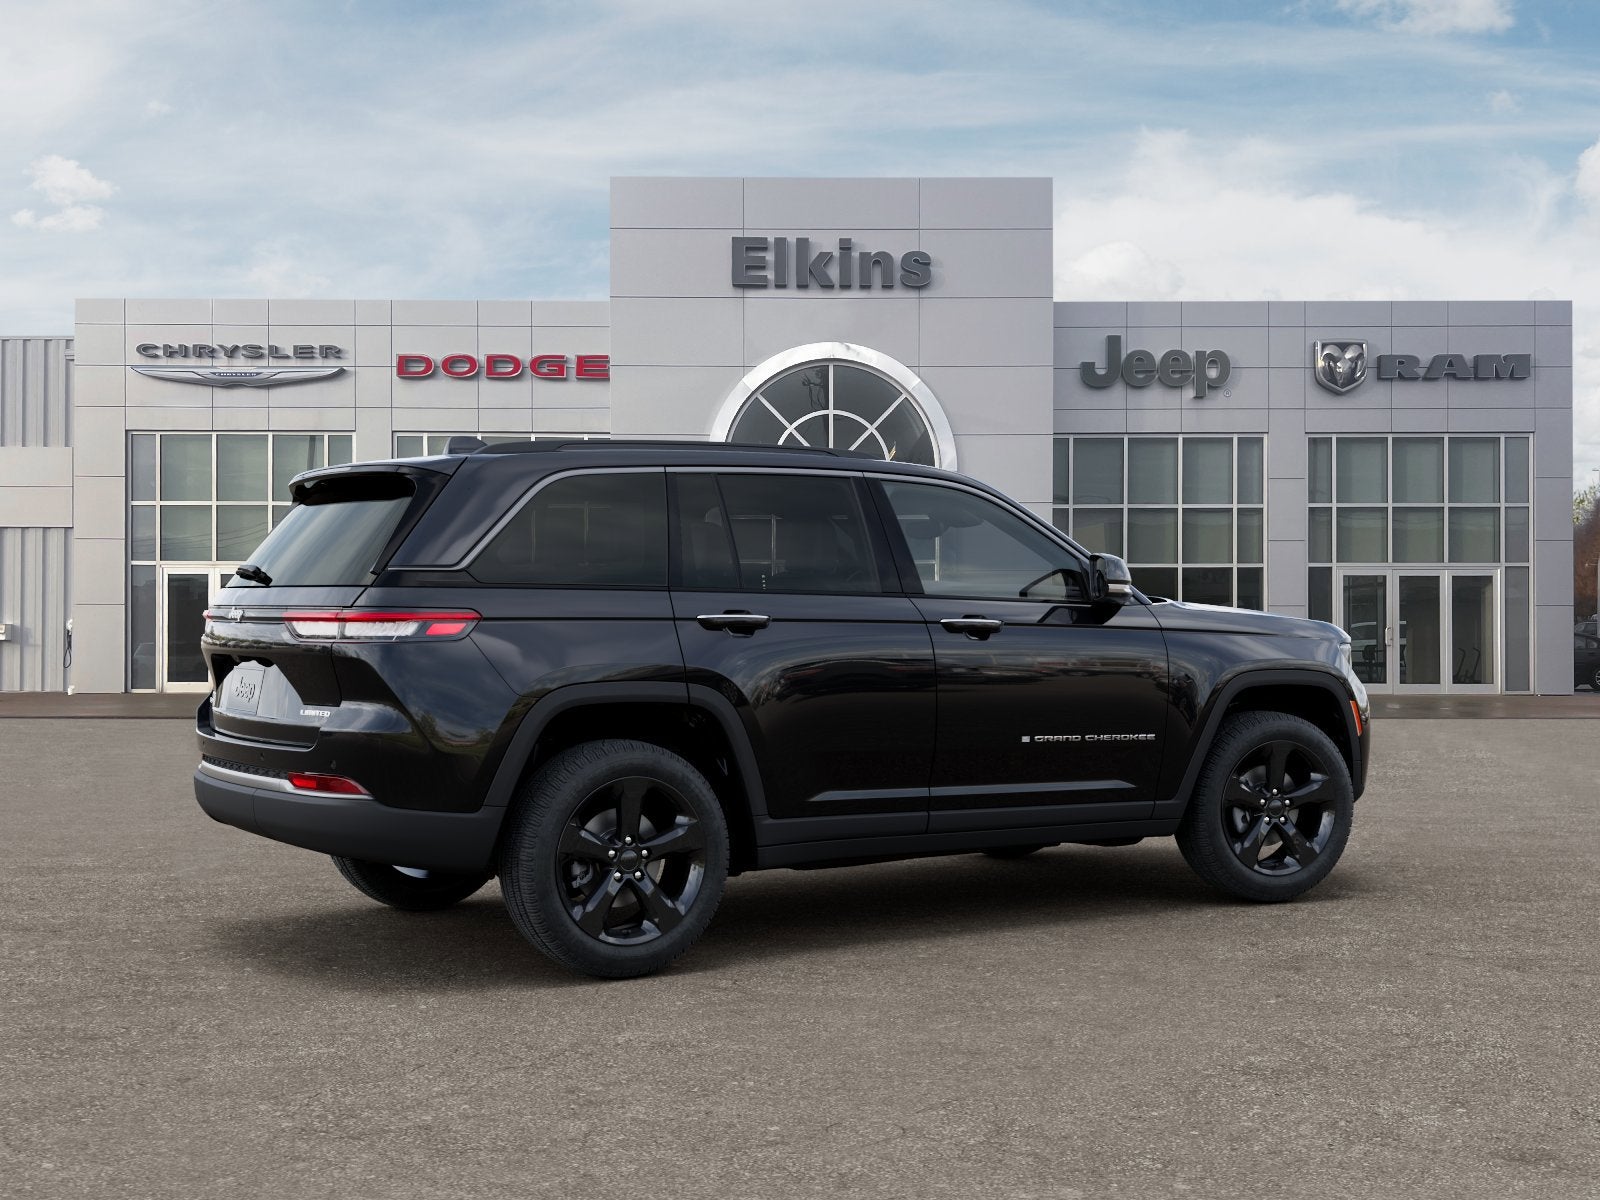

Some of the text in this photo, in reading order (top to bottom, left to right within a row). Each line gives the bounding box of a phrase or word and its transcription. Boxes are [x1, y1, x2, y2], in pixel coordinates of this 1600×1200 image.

[731, 236, 933, 289] Elkins
[135, 343, 343, 359] CHRYSLER
[395, 353, 610, 380] DODGE
[1079, 334, 1231, 399] Jeep
[1377, 353, 1531, 380] RAM
[300, 709, 331, 718] LIMITED
[1084, 733, 1156, 741] CHEROKEE
